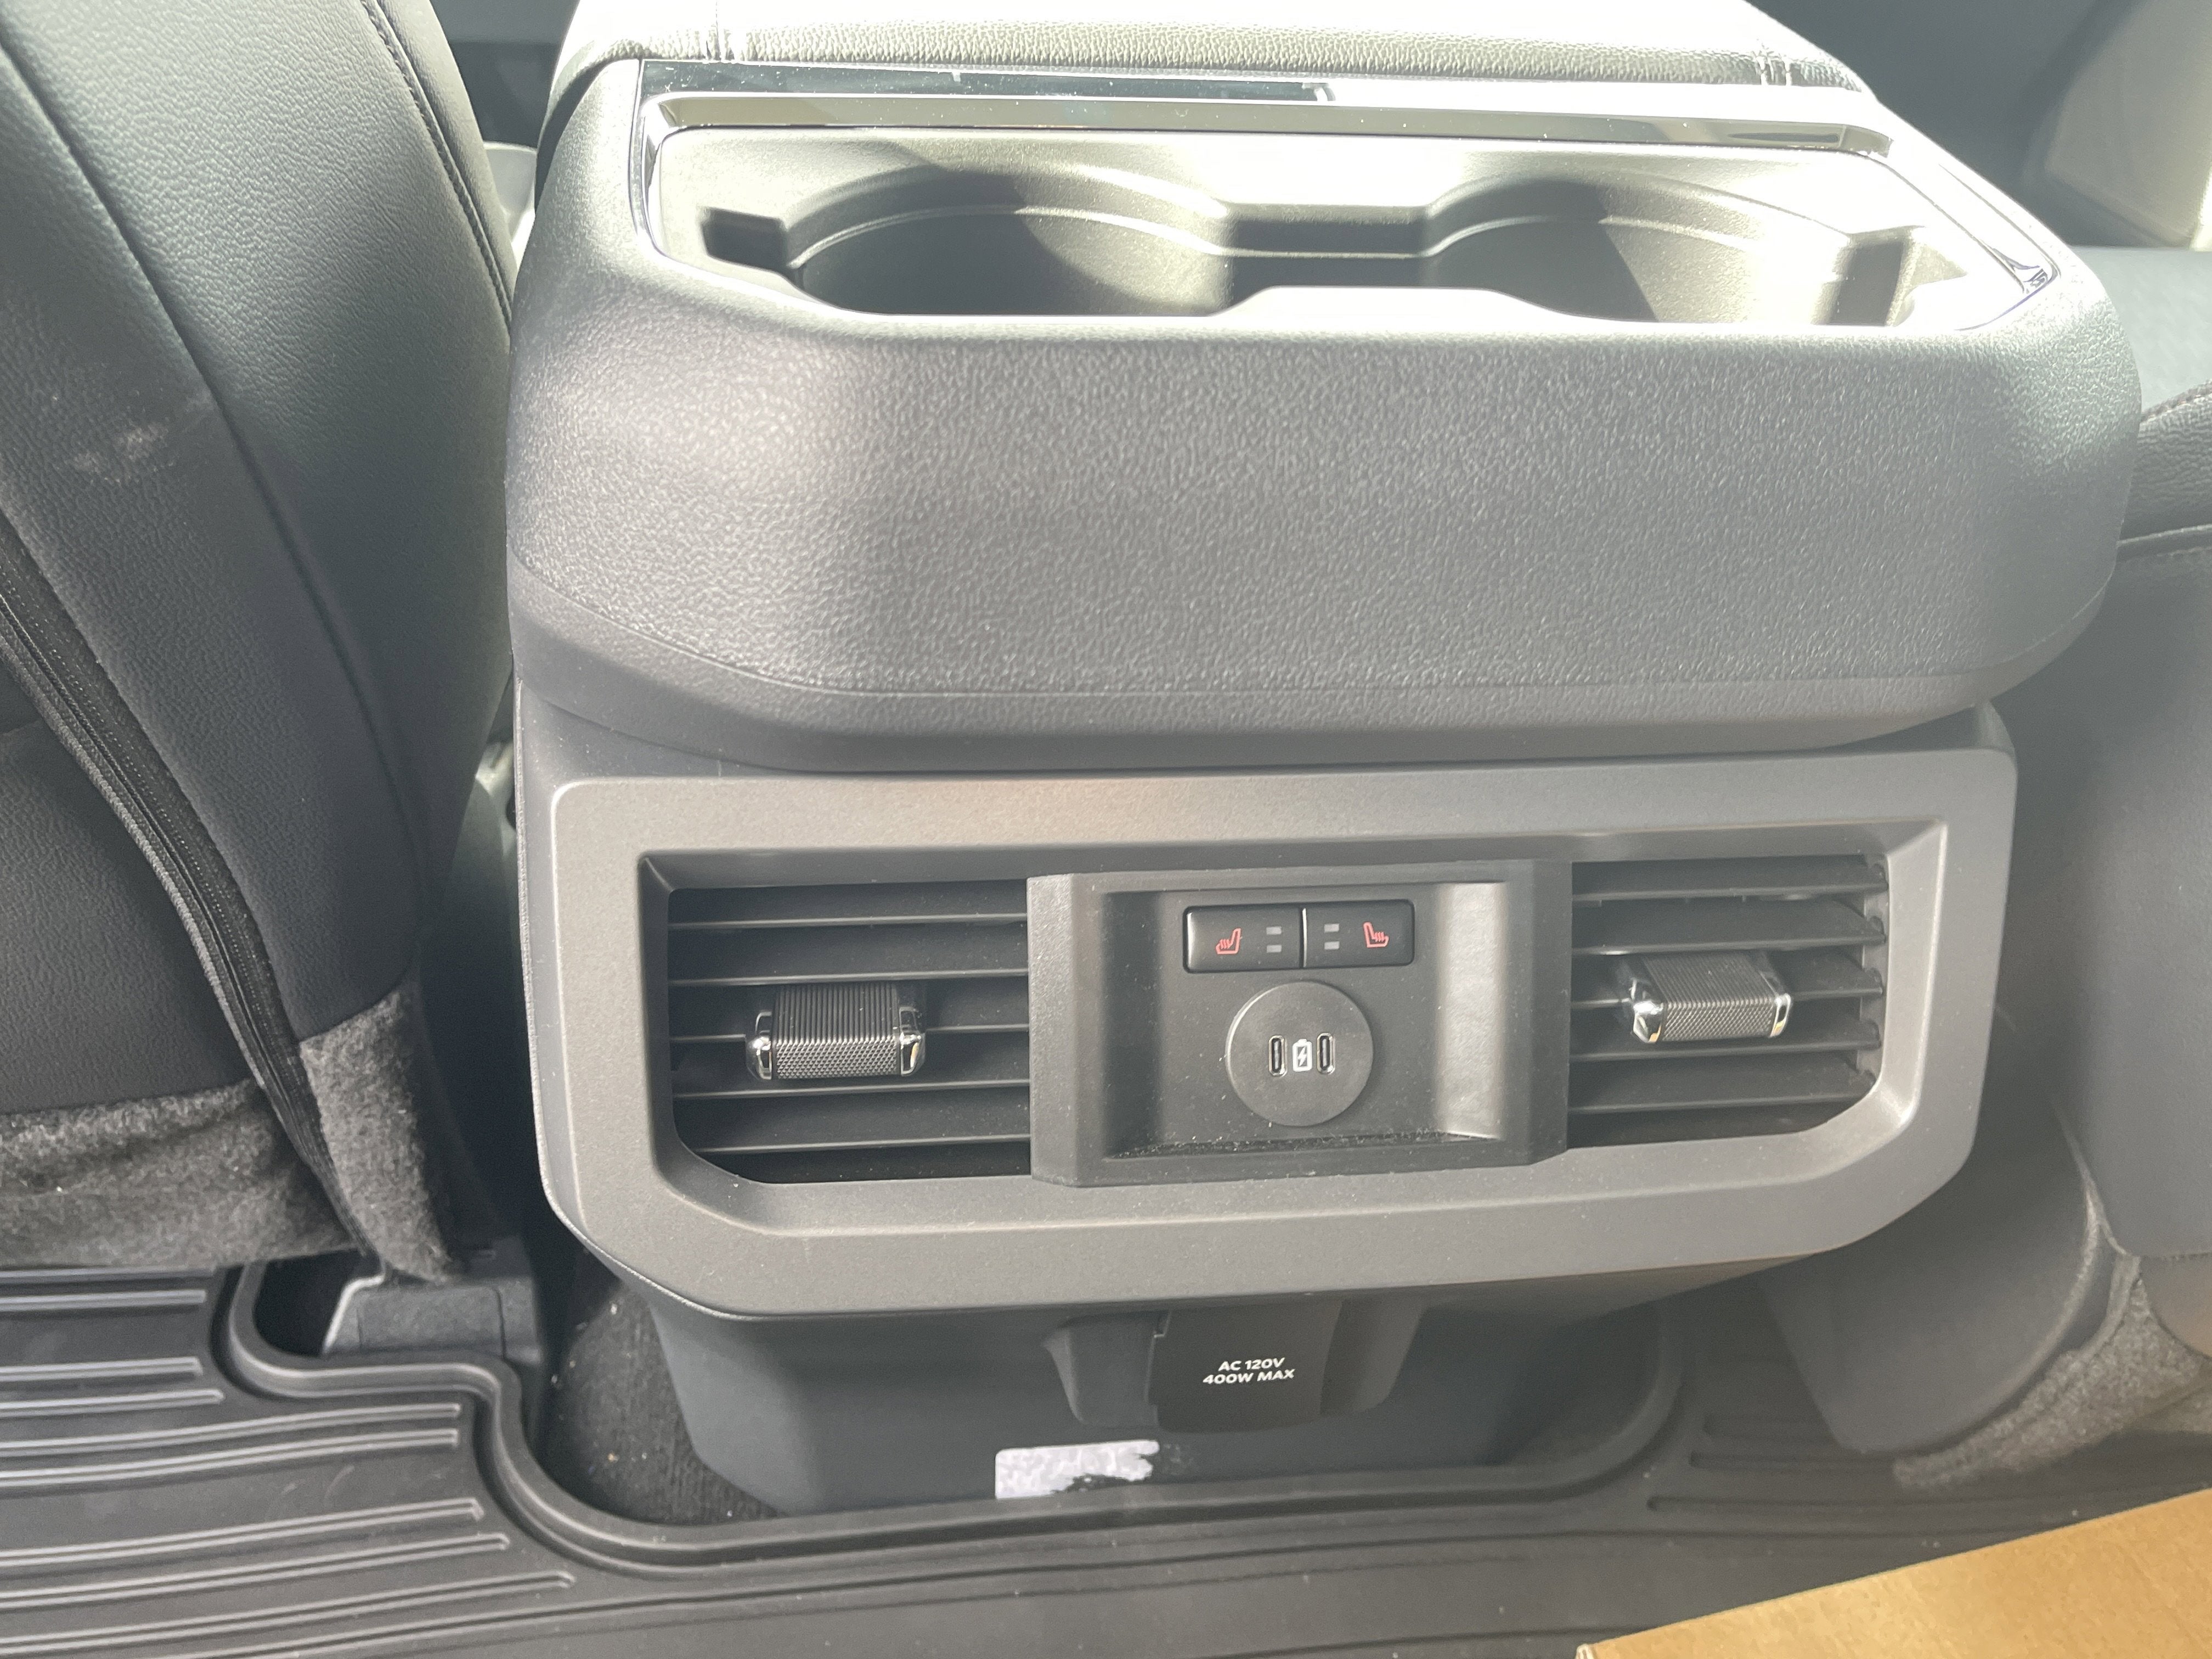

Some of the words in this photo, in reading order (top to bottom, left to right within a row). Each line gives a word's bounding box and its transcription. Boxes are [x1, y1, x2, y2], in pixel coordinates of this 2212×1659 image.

[1217, 1360, 1242, 1372] AC
[1244, 1357, 1285, 1370] 120V
[1202, 1372, 1254, 1385] 400W
[1256, 1368, 1295, 1382] MAX
